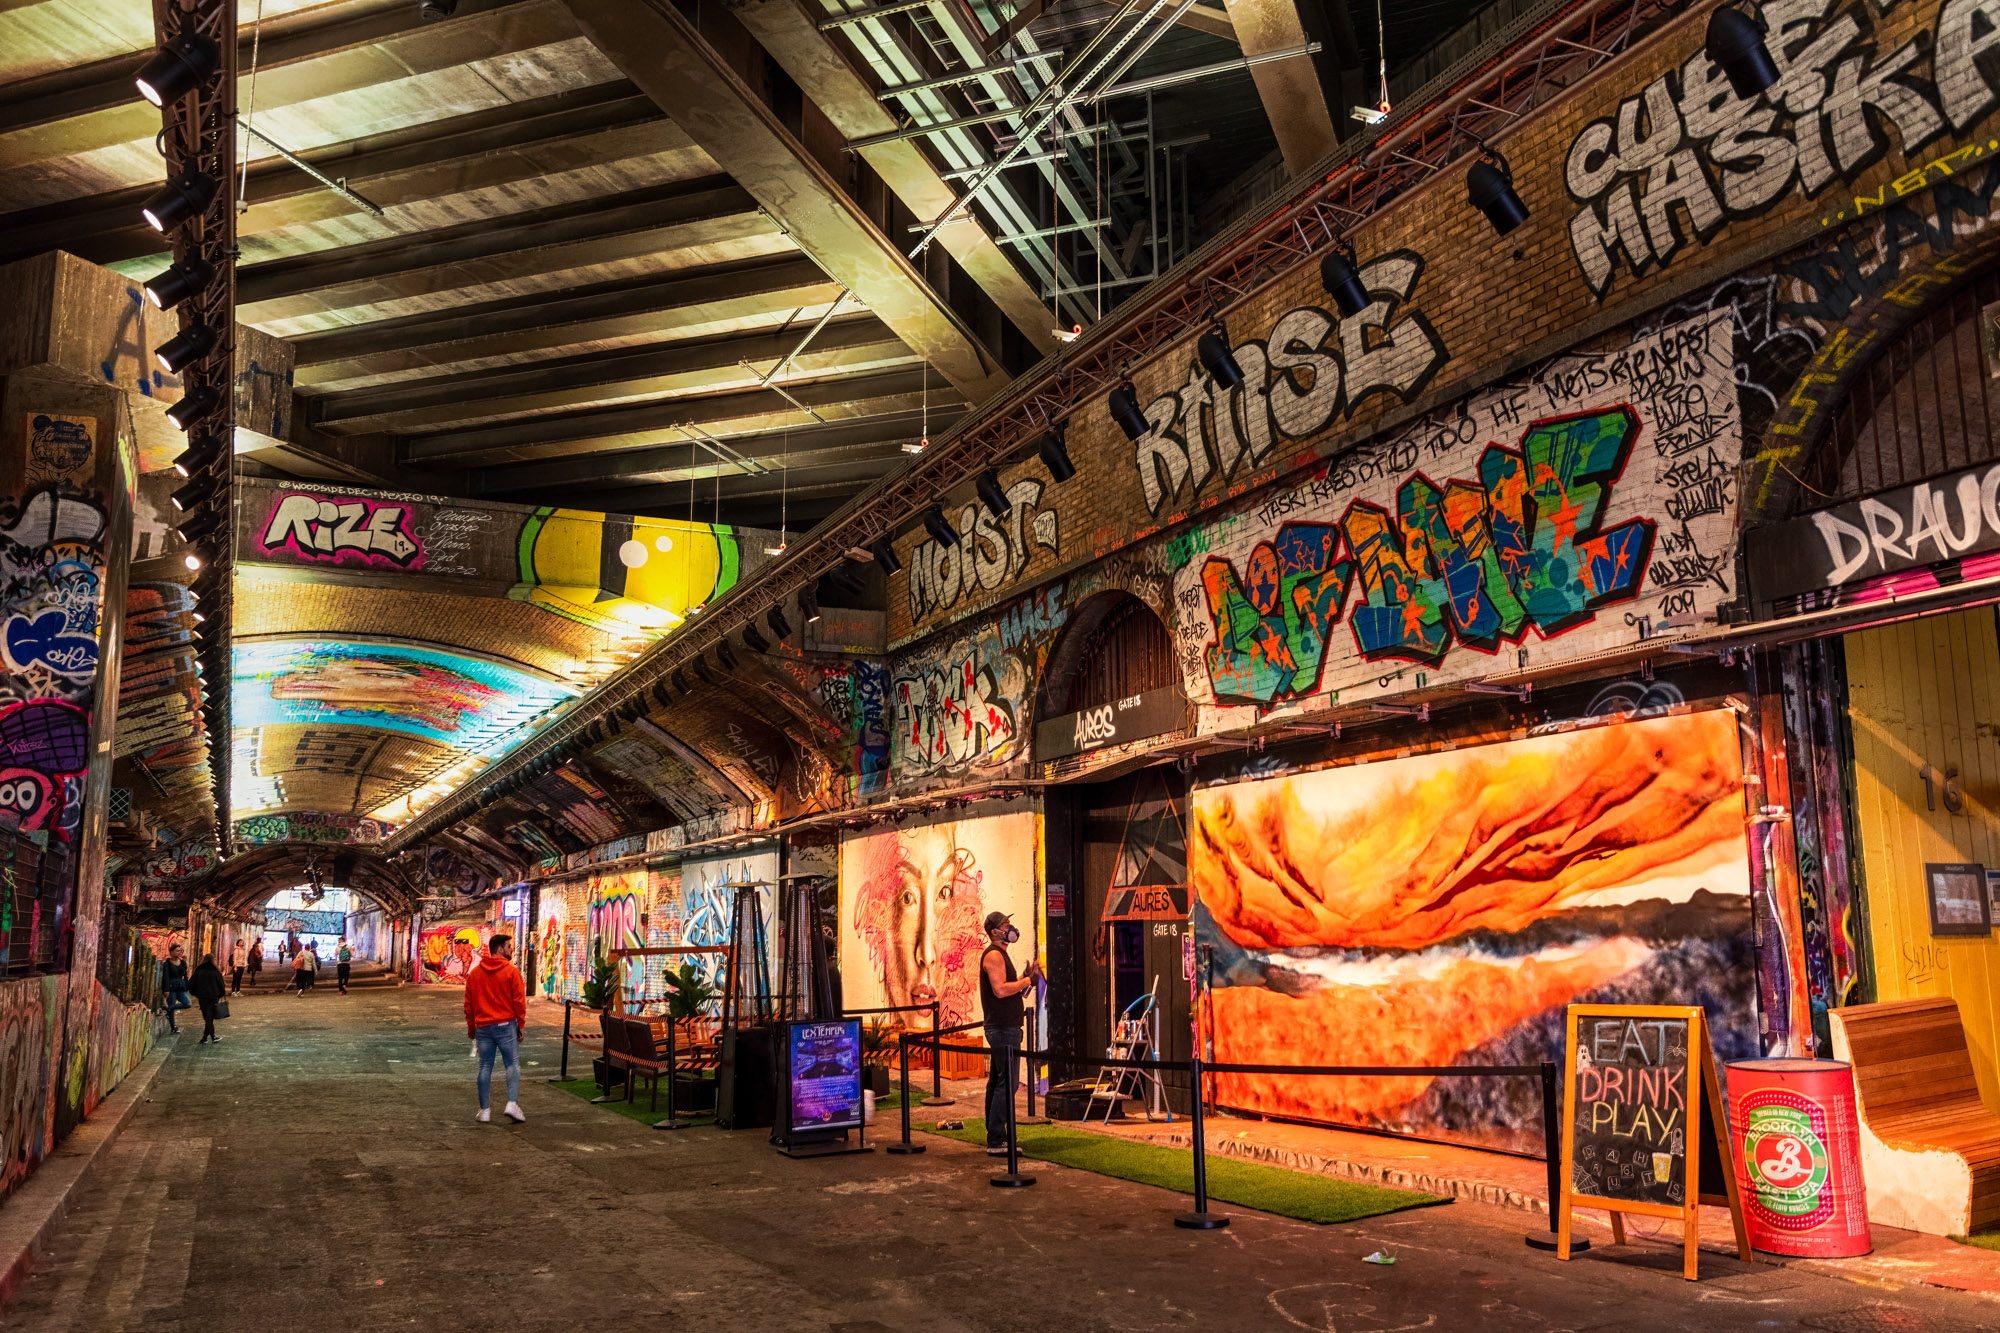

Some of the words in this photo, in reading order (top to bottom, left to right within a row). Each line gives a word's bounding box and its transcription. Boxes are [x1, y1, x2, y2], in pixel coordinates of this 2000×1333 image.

[1658, 589, 1697, 618] 2019
[1073, 704, 1116, 750] AURES
[1919, 763, 1963, 813] 16
[1132, 891, 1170, 913] AURES
[1152, 923, 1168, 937] GATE
[1169, 923, 1178, 937] 18
[1594, 1019, 1687, 1066] EAT
[1581, 1065, 1685, 1113] DRINK
[1591, 1098, 1679, 1147] PLAY
[1749, 1121, 1818, 1147] BROOKLYN
[1754, 1178, 1790, 1201] EAST
[1797, 1181, 1821, 1199] IPA
